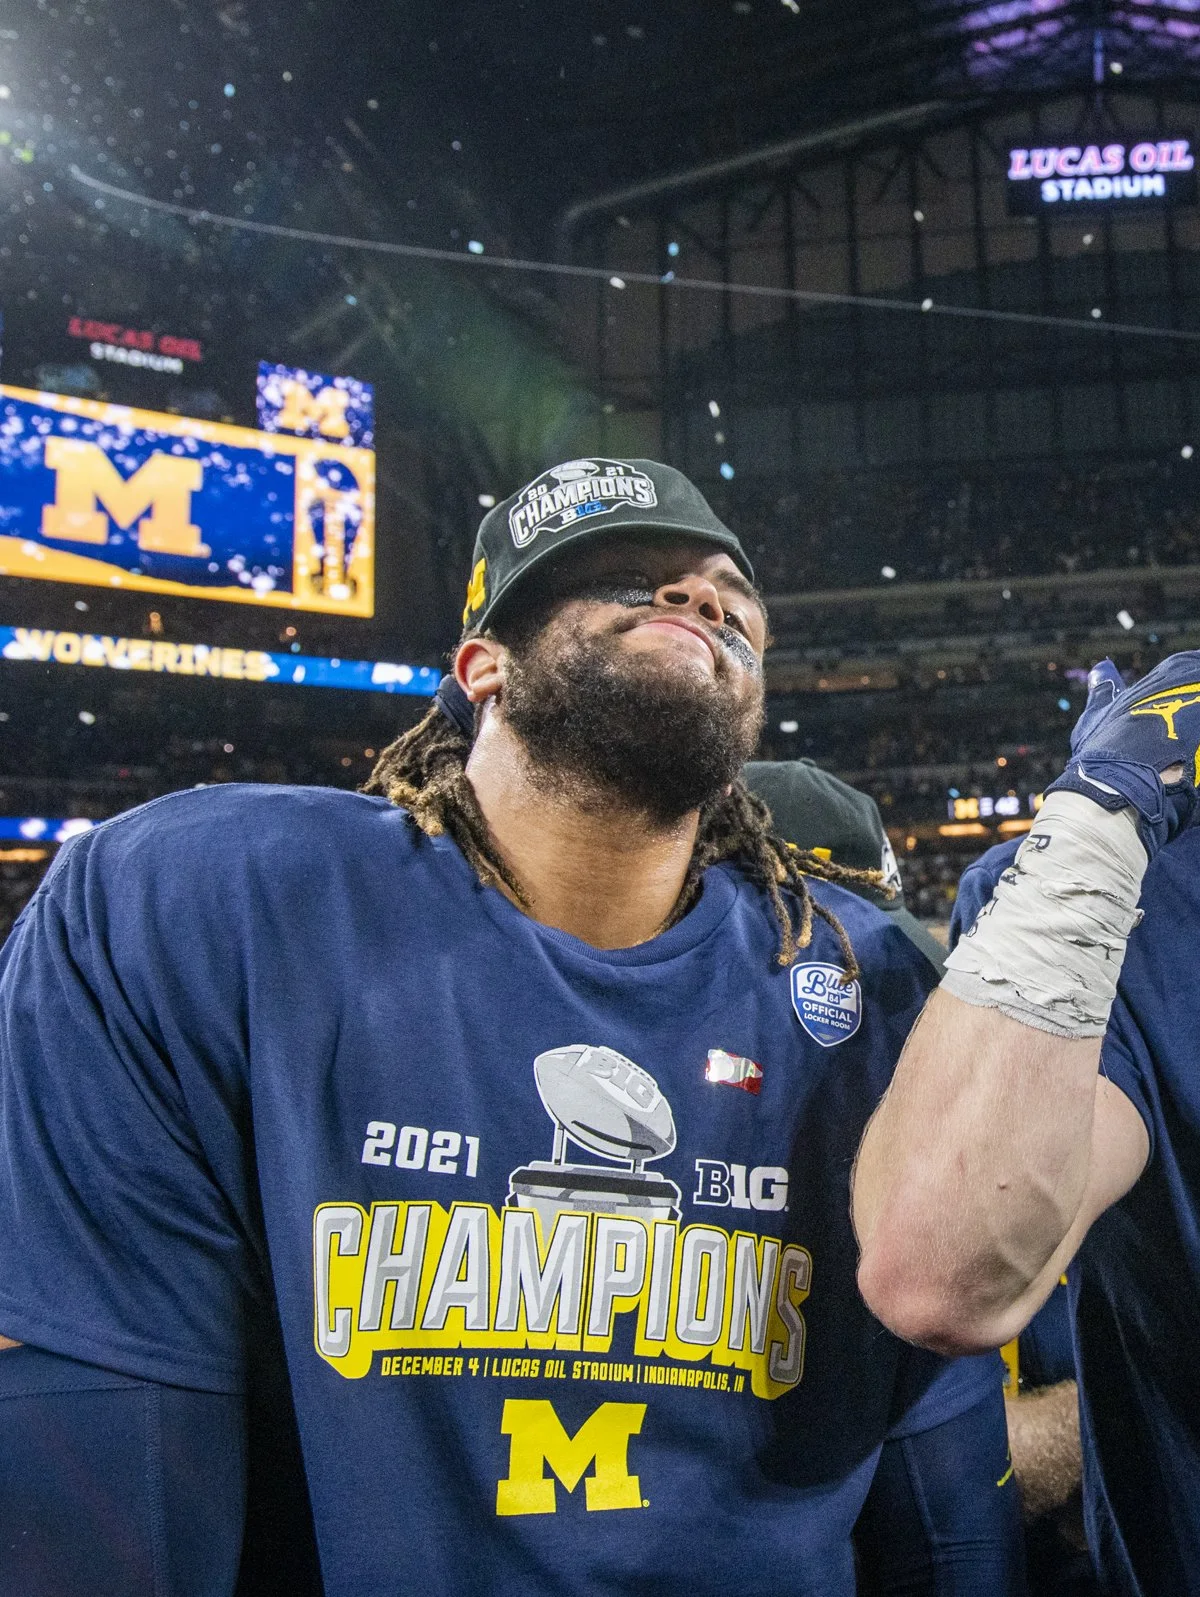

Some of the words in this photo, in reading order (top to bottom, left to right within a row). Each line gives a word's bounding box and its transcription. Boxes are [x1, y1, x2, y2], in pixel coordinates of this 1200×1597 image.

[1007, 144, 1125, 180] LUCAS
[1129, 140, 1195, 173] OIL
[1041, 174, 1166, 202] STADIUM
[90, 342, 184, 375] STADIUM
[42, 435, 203, 558] M
[527, 484, 548, 500] 20
[605, 465, 625, 477] 21
[511, 475, 653, 542] CHAMPIONS
[14, 627, 270, 681] WOLVERINES
[802, 1001, 853, 1023] OFFICIAL
[828, 993, 839, 1004] 84
[804, 1012, 830, 1025] LOCKER
[830, 1020, 851, 1030] ROOM
[361, 1120, 480, 1178] 2021
[313, 1202, 812, 1392] CHAMPIONS
[381, 1356, 463, 1376] DECEMBER
[468, 1357, 479, 1377] 4
[492, 1360, 539, 1378] LUCAS
[544, 1361, 567, 1380] OIL
[572, 1362, 634, 1383] STADIUM
[644, 1366, 731, 1393] INDIANAPOLIS,
[733, 1374, 745, 1393] IN
[496, 1398, 648, 1517] M
